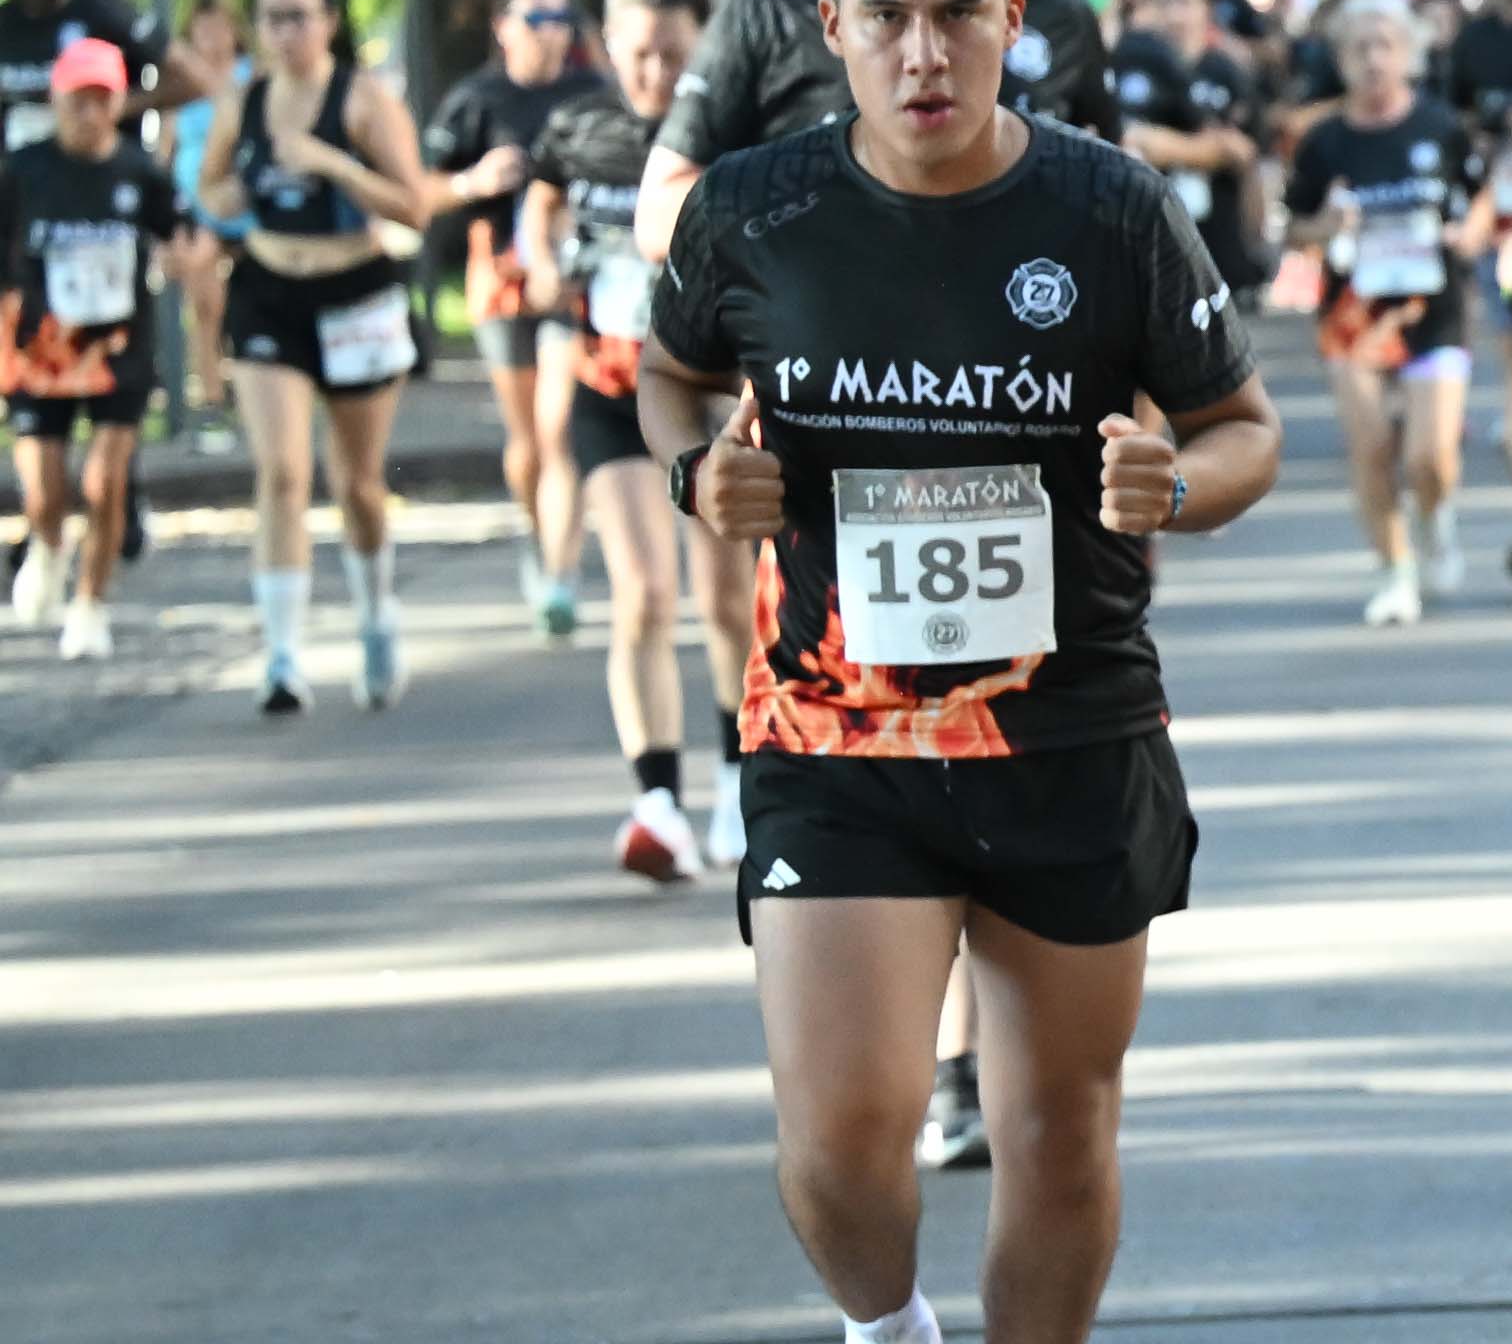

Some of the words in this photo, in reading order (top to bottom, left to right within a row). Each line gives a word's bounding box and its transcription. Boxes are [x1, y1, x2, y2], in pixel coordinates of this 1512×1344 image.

[830, 354, 1073, 415] MARATÓN
[894, 473, 1021, 509] MARATÓN
[865, 533, 1025, 603] 185
